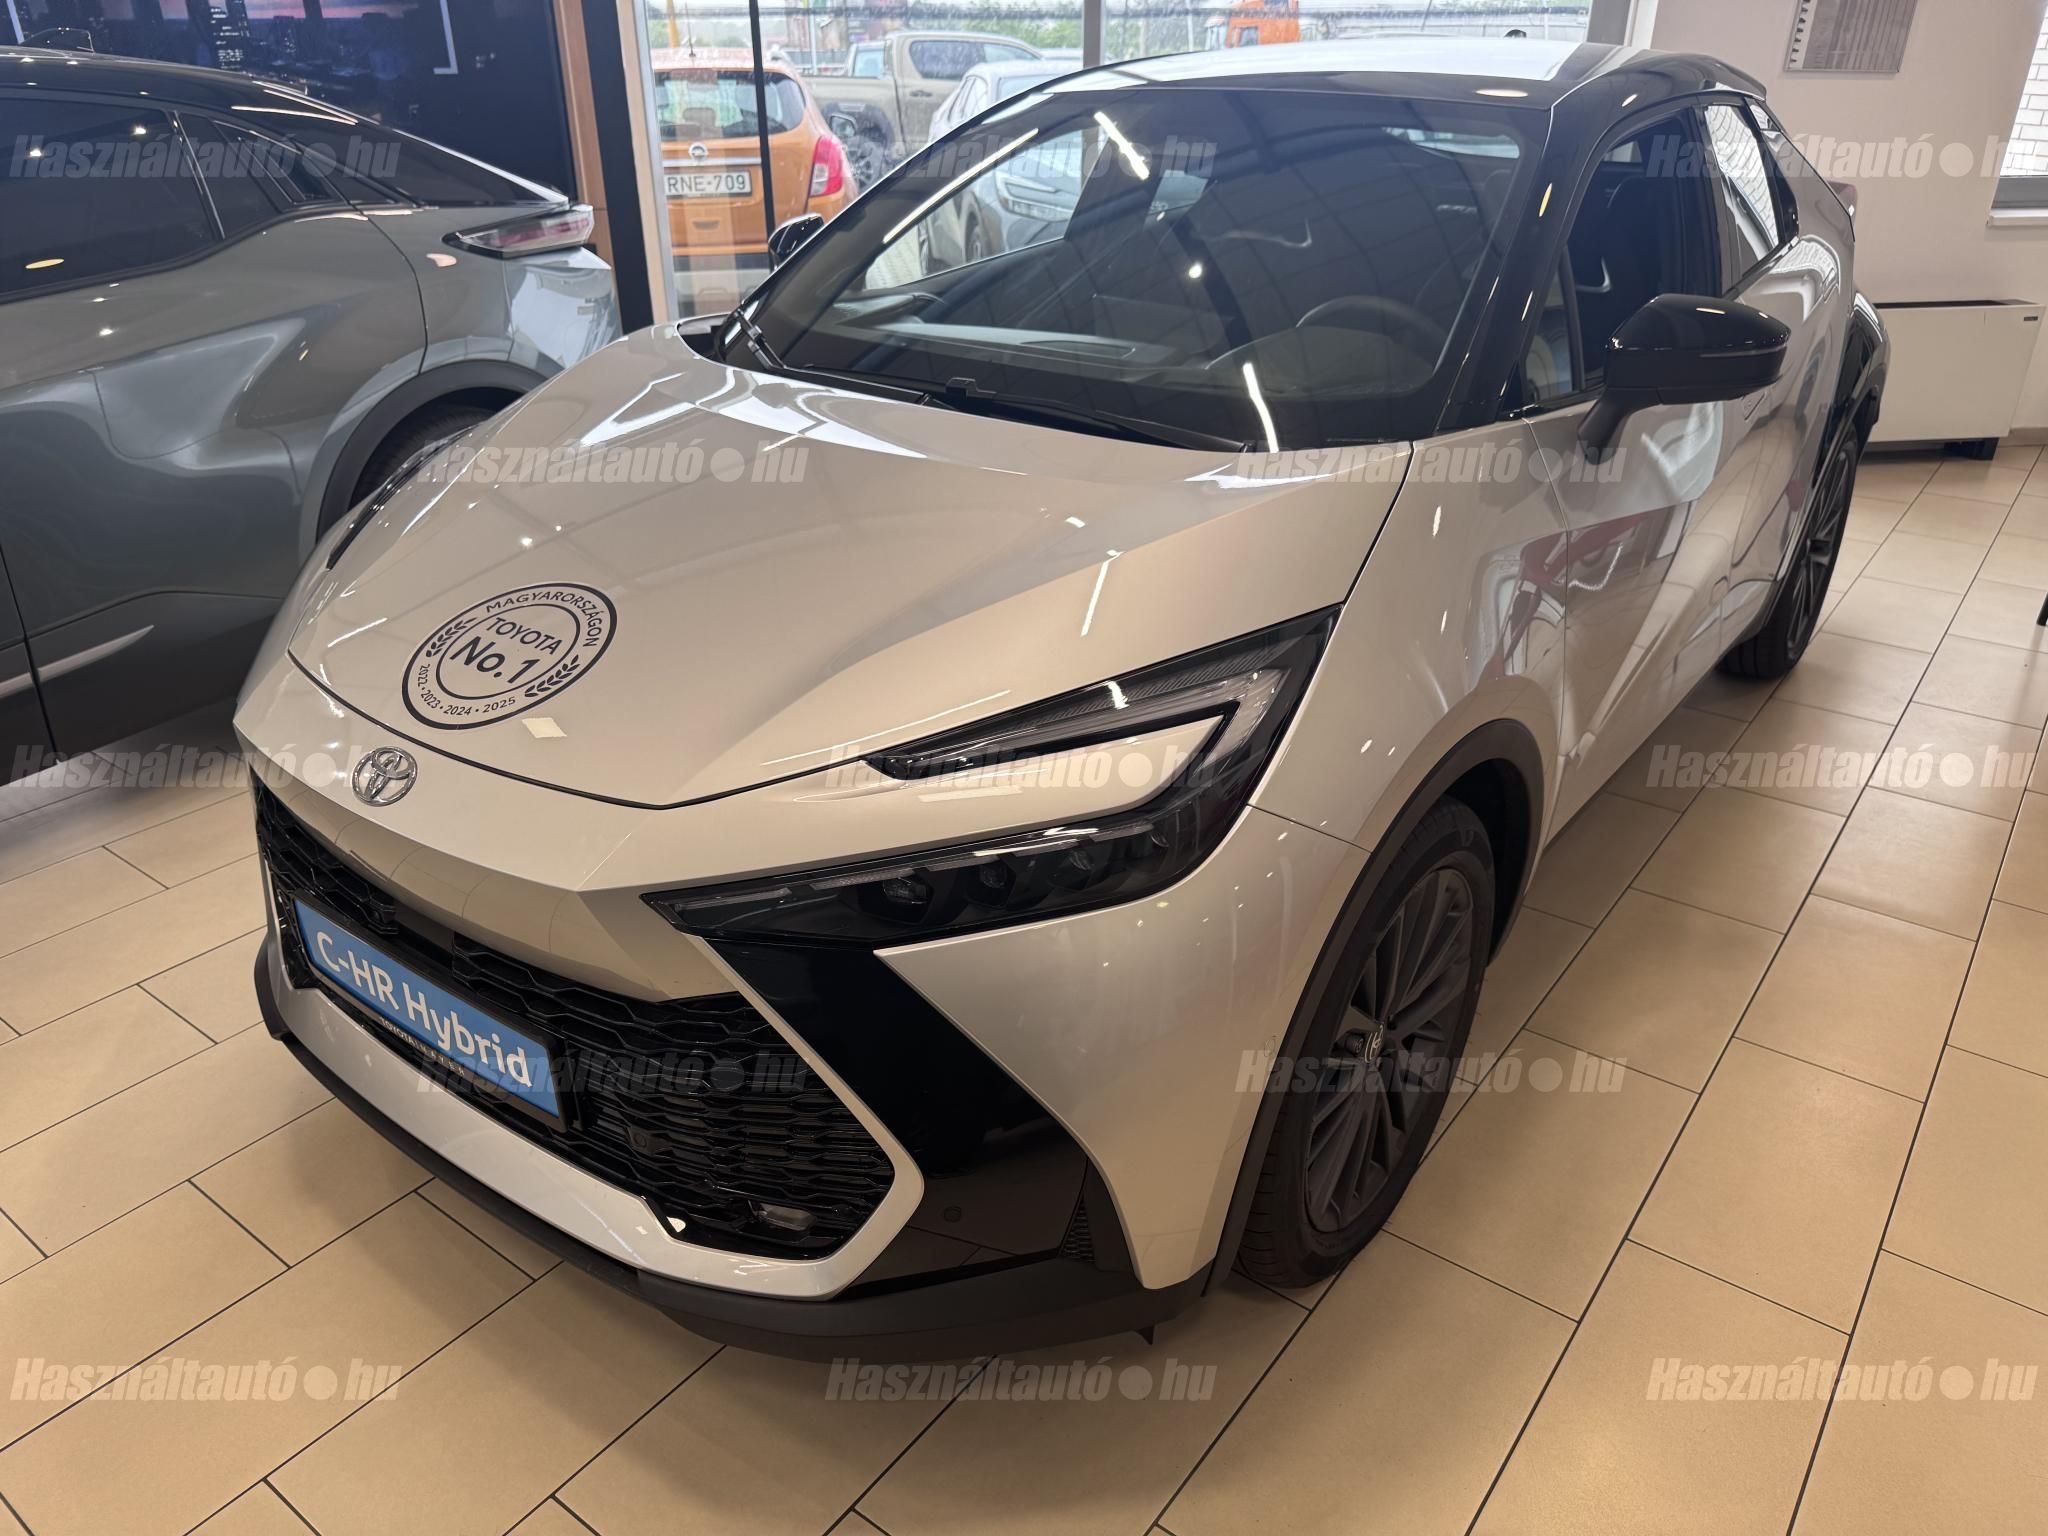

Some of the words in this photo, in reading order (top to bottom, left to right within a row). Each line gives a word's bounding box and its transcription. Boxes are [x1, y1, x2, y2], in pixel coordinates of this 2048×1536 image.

[666, 174, 746, 193] RNE-709
[486, 590, 602, 648] MAGYARORSZÁGON
[486, 617, 563, 655] TOYOTA
[449, 635, 505, 678] No.
[507, 658, 541, 684] 1
[420, 689, 441, 709] 2023
[443, 704, 472, 717] 2024
[482, 696, 516, 714] 2025
[316, 931, 400, 1010] C-HR
[402, 981, 532, 1088] Hybrid
